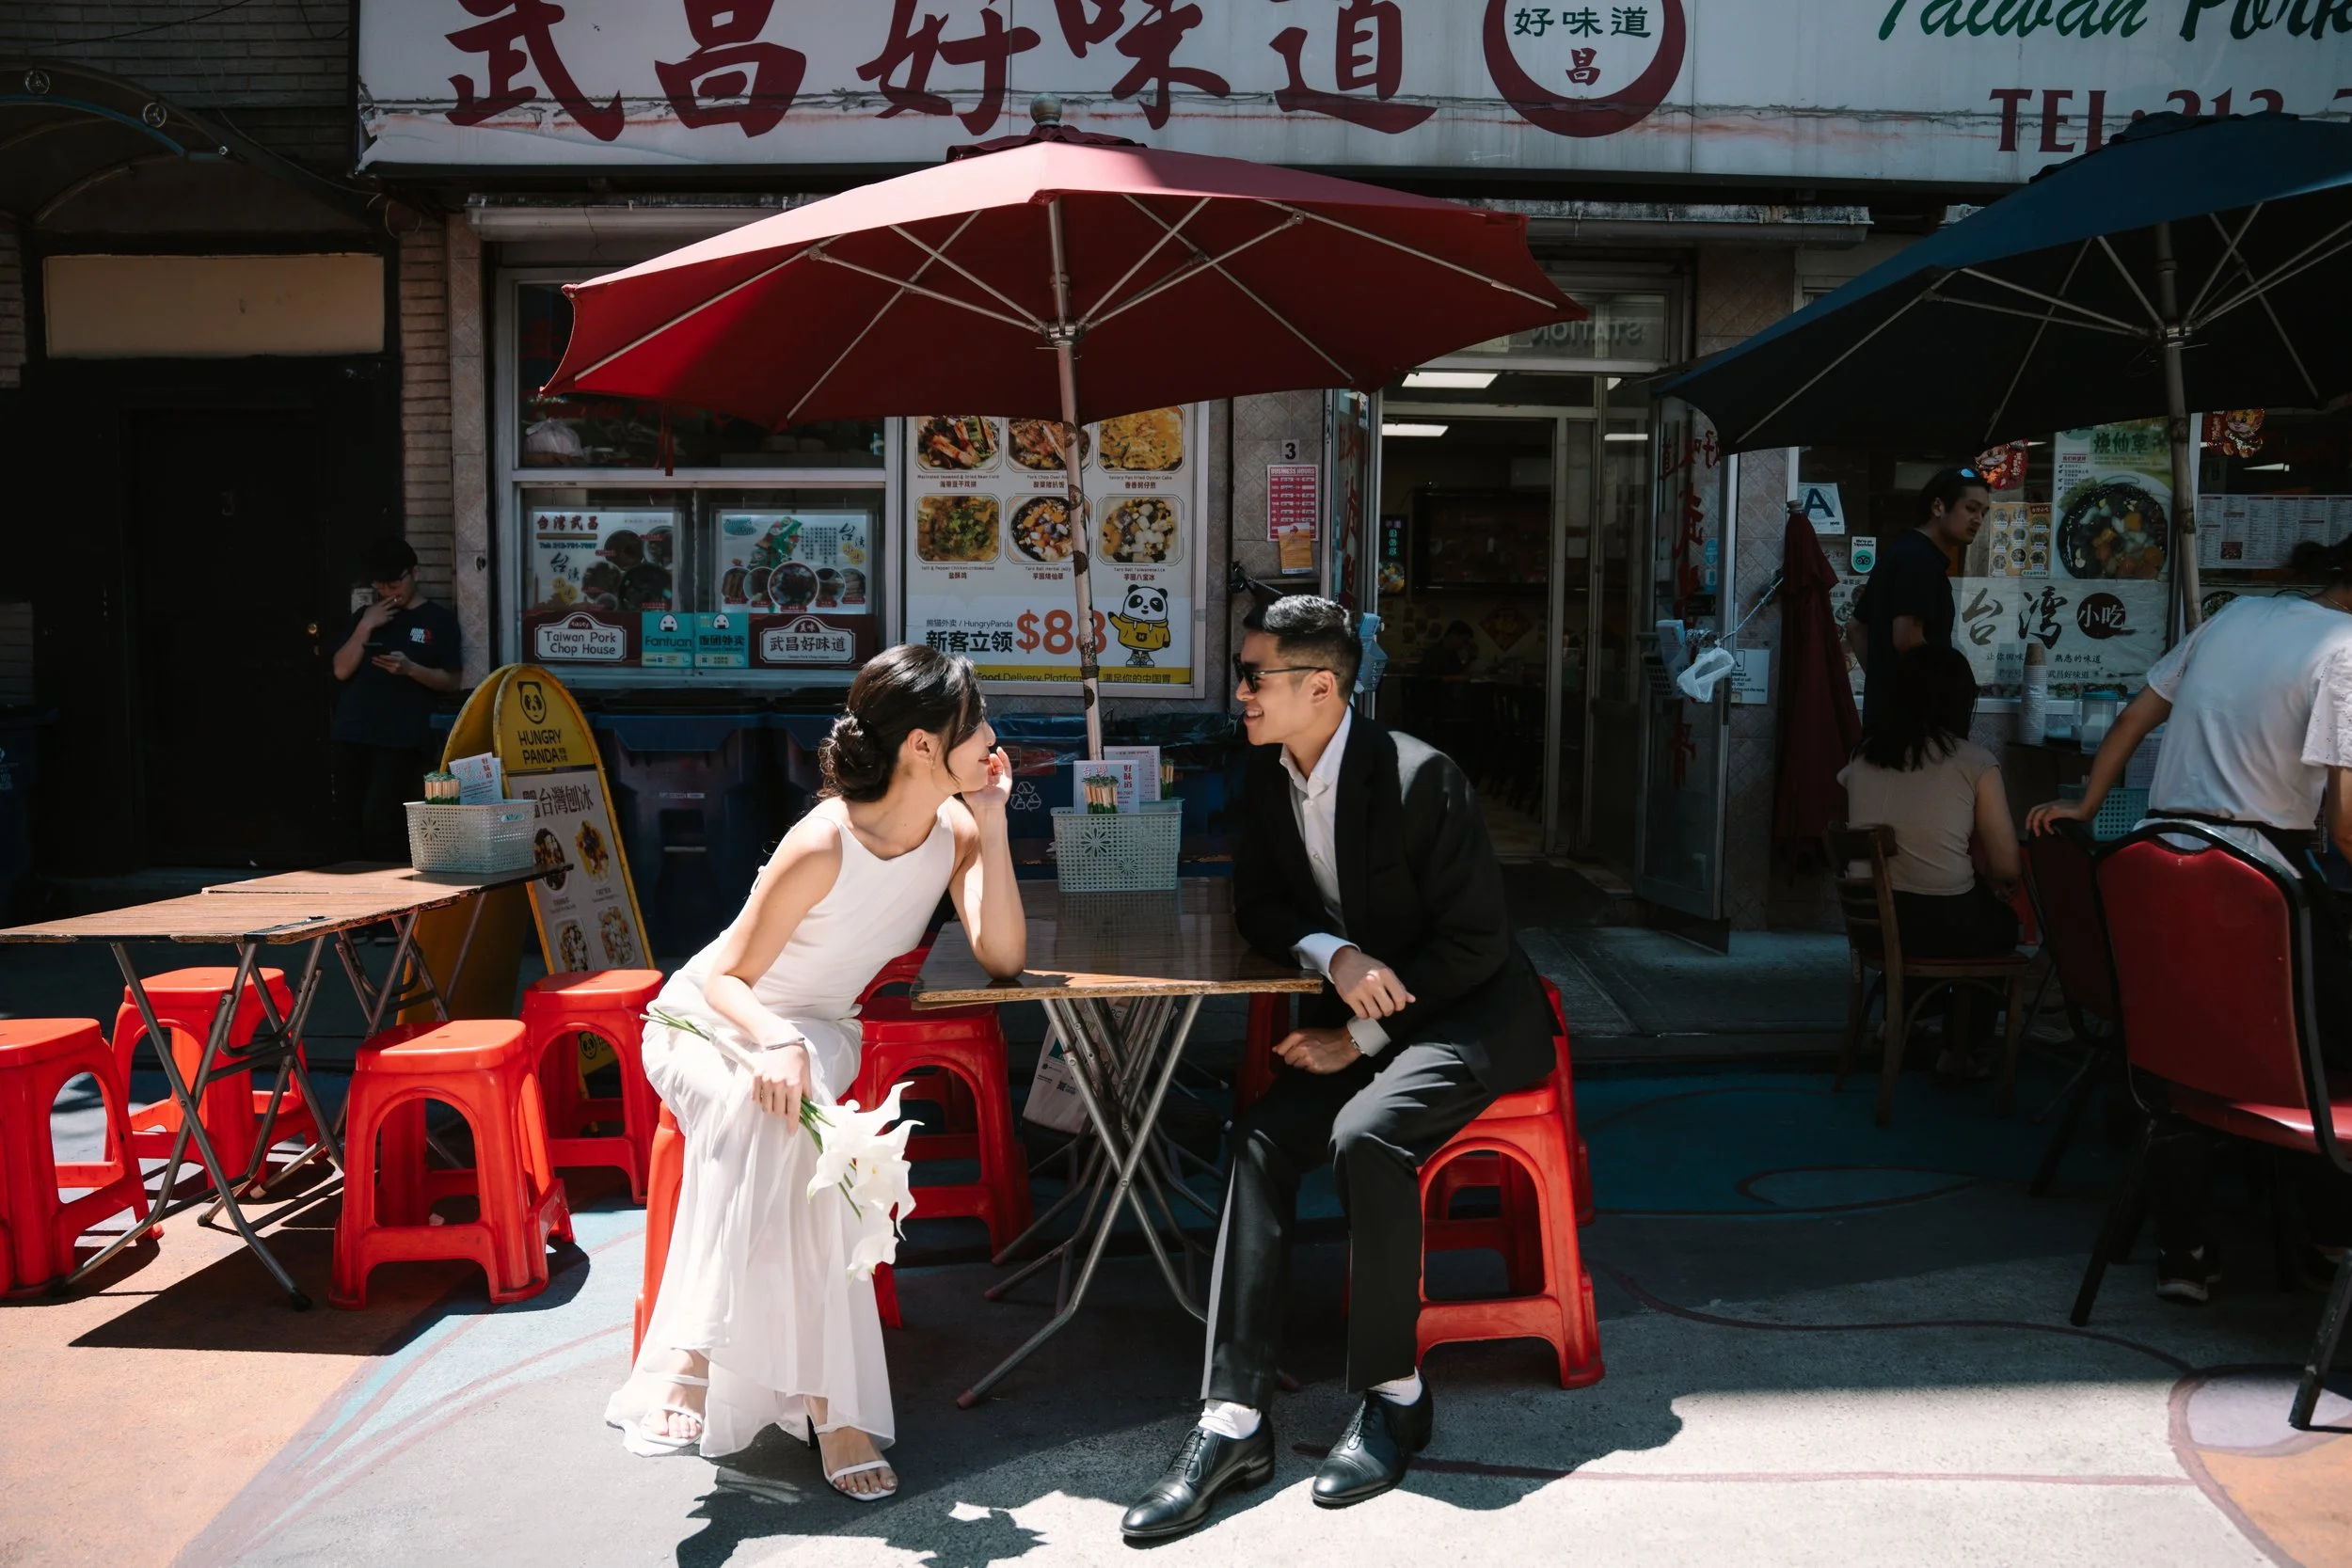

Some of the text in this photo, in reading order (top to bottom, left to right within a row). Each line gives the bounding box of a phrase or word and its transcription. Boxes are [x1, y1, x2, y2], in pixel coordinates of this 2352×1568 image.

[1513, 6, 1652, 40] 好味道
[1285, 442, 1296, 460] 3
[1804, 488, 1835, 517] A
[963, 620, 1013, 628] HungryPanda
[1962, 585, 2068, 649] 台湾
[2077, 603, 2125, 628] 小吃
[544, 630, 616, 643] Taiwan Pork
[644, 635, 692, 648] Fantuan
[770, 636, 846, 652] 武昌好味道
[926, 630, 1013, 653] 新客立领
[550, 642, 615, 656] Chop House
[1003, 673, 1041, 681] Delivery
[517, 729, 562, 746] HUNGRY
[522, 747, 560, 765] PANDA
